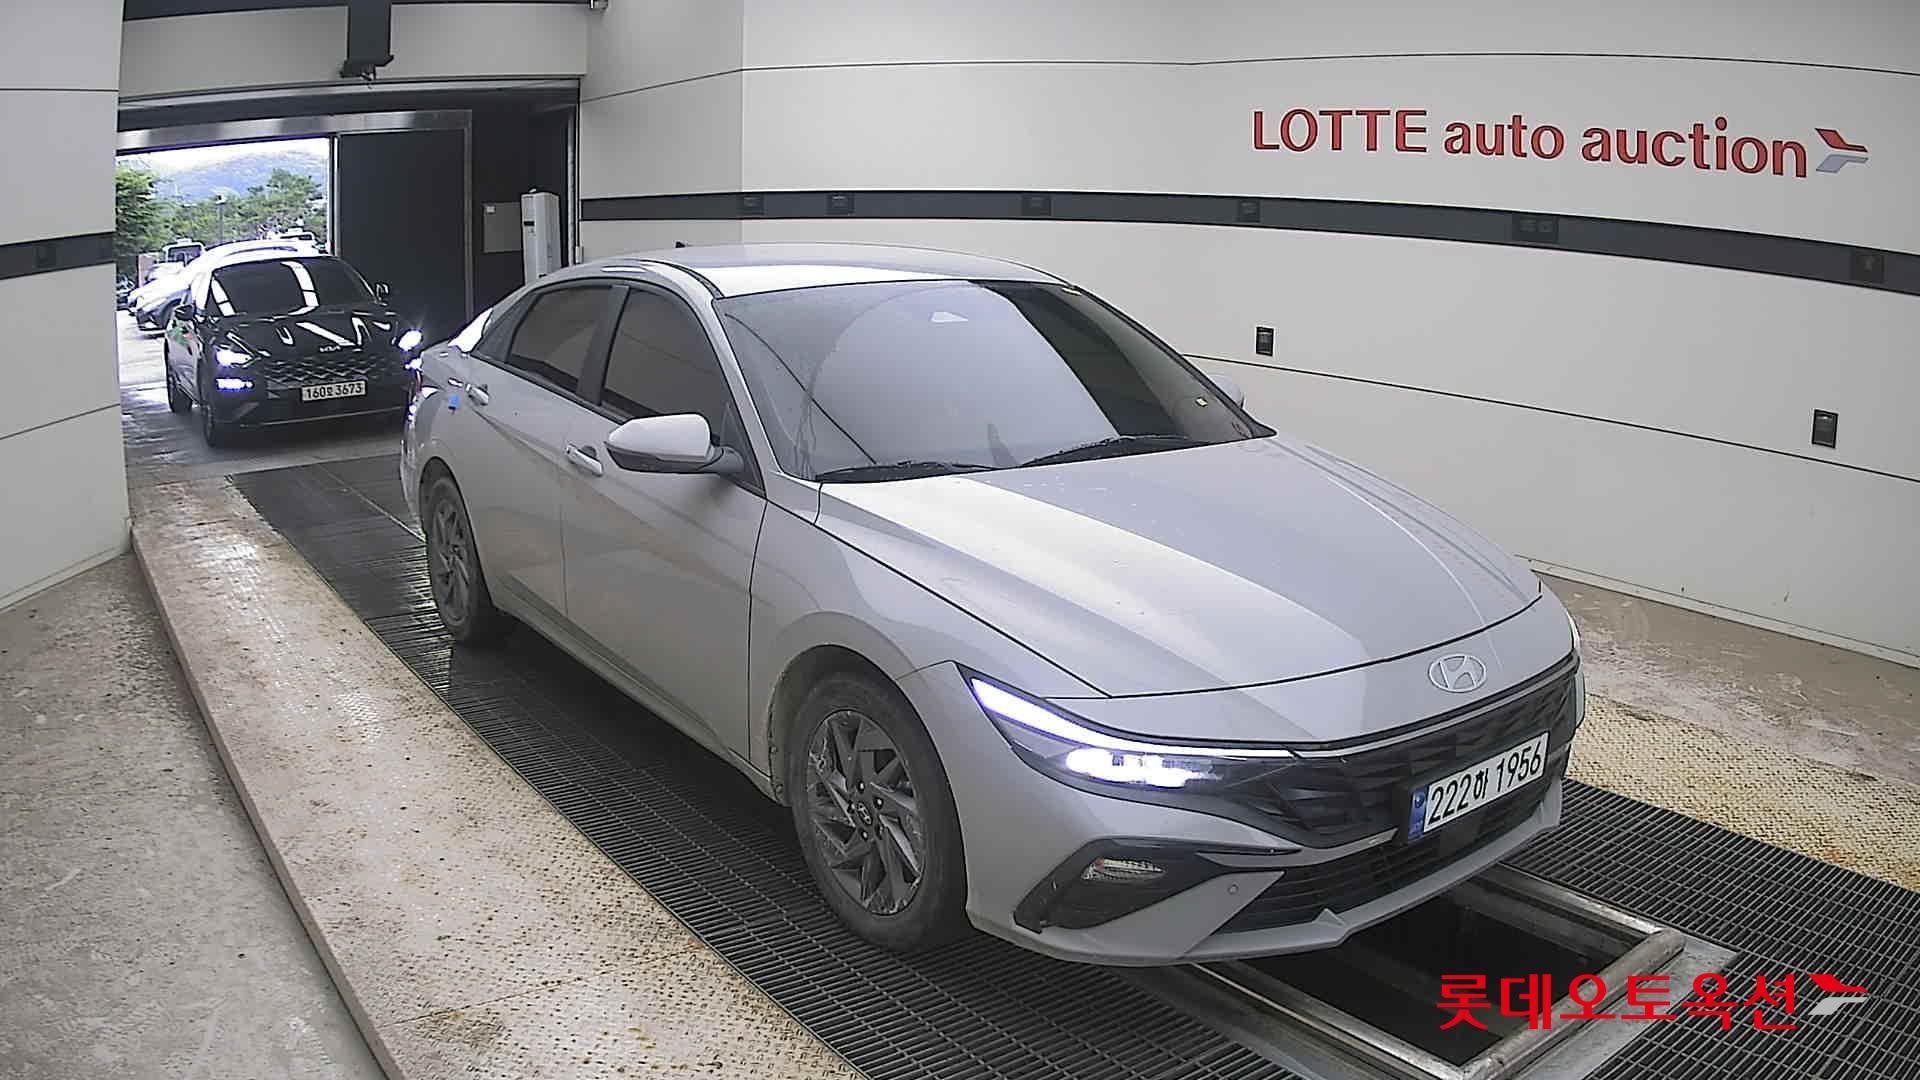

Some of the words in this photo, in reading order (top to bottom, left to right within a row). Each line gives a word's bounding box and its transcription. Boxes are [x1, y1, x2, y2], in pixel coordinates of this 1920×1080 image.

[1252, 107, 1428, 154] LOTTE
[1443, 114, 1566, 160] auto
[1581, 116, 1808, 178] auction
[1427, 767, 1489, 826] 222하
[1497, 740, 1542, 793] 1956
